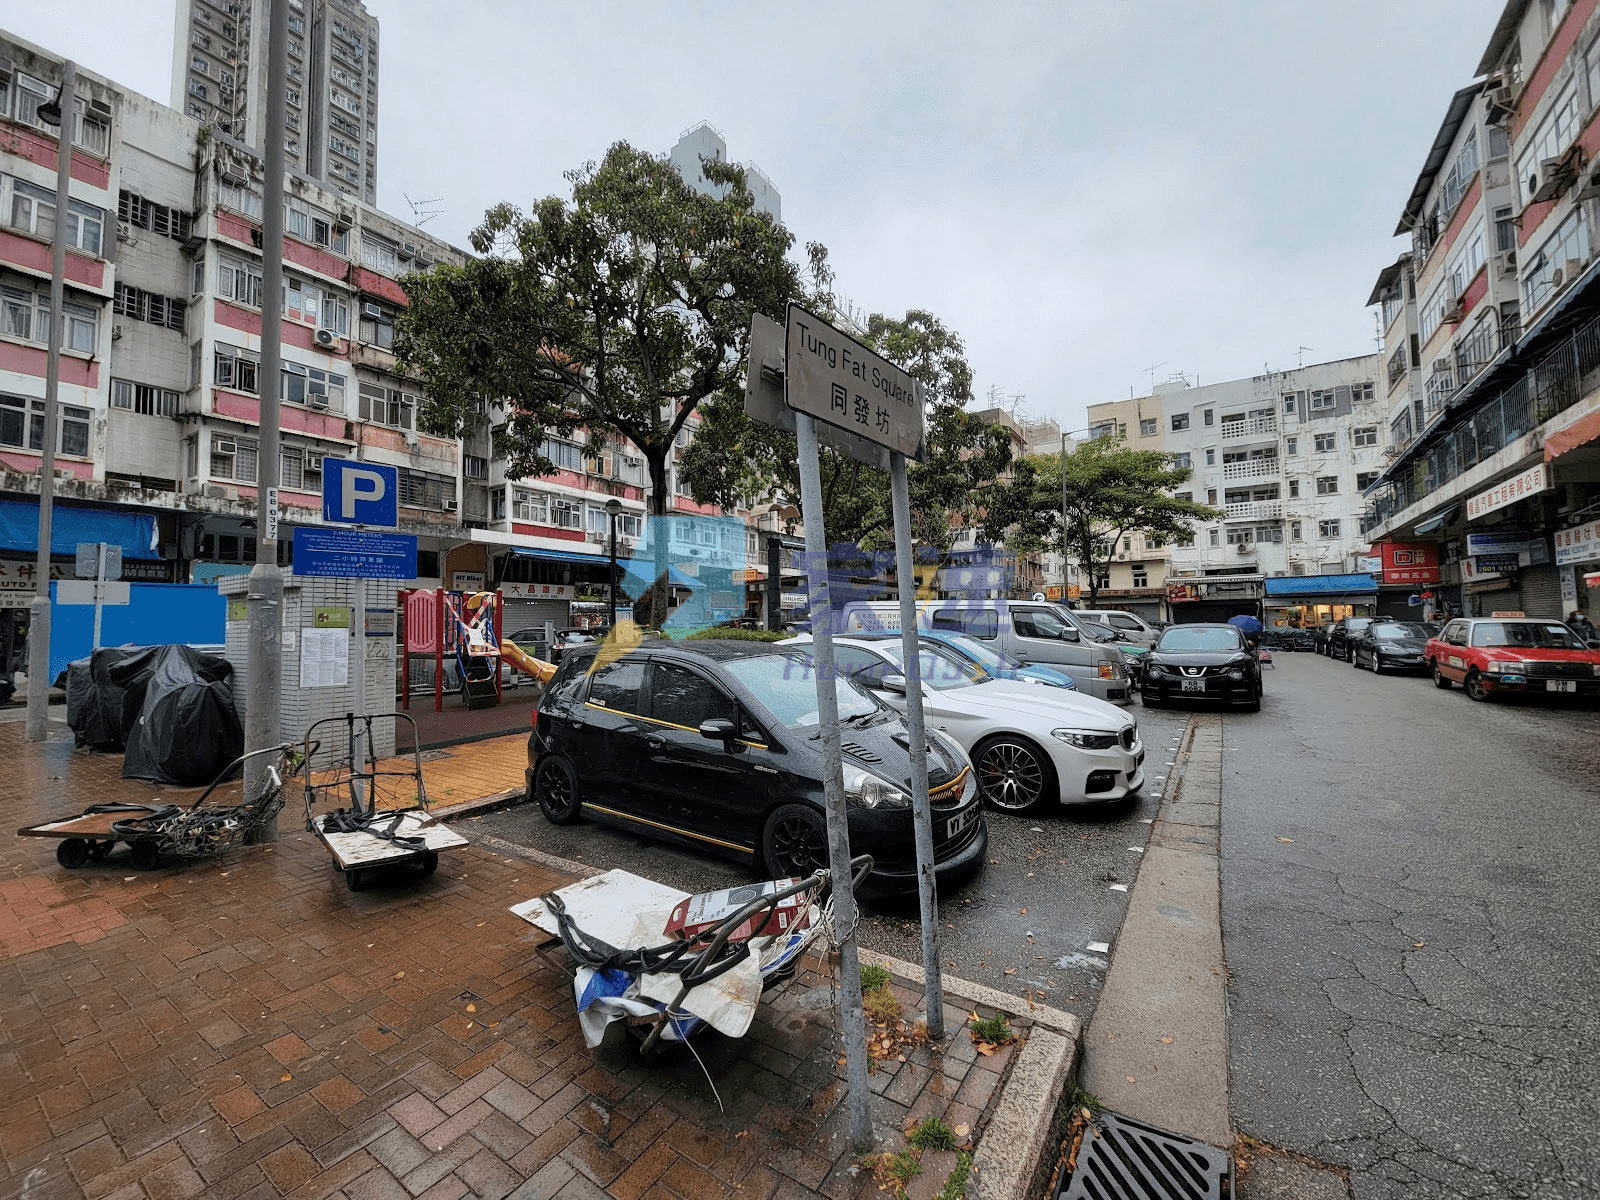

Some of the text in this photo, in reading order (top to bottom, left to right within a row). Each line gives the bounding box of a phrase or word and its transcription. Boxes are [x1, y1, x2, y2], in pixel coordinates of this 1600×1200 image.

[796, 321, 914, 408] Tung Fat Square
[831, 382, 890, 435] 同發坊
[341, 466, 386, 519] P
